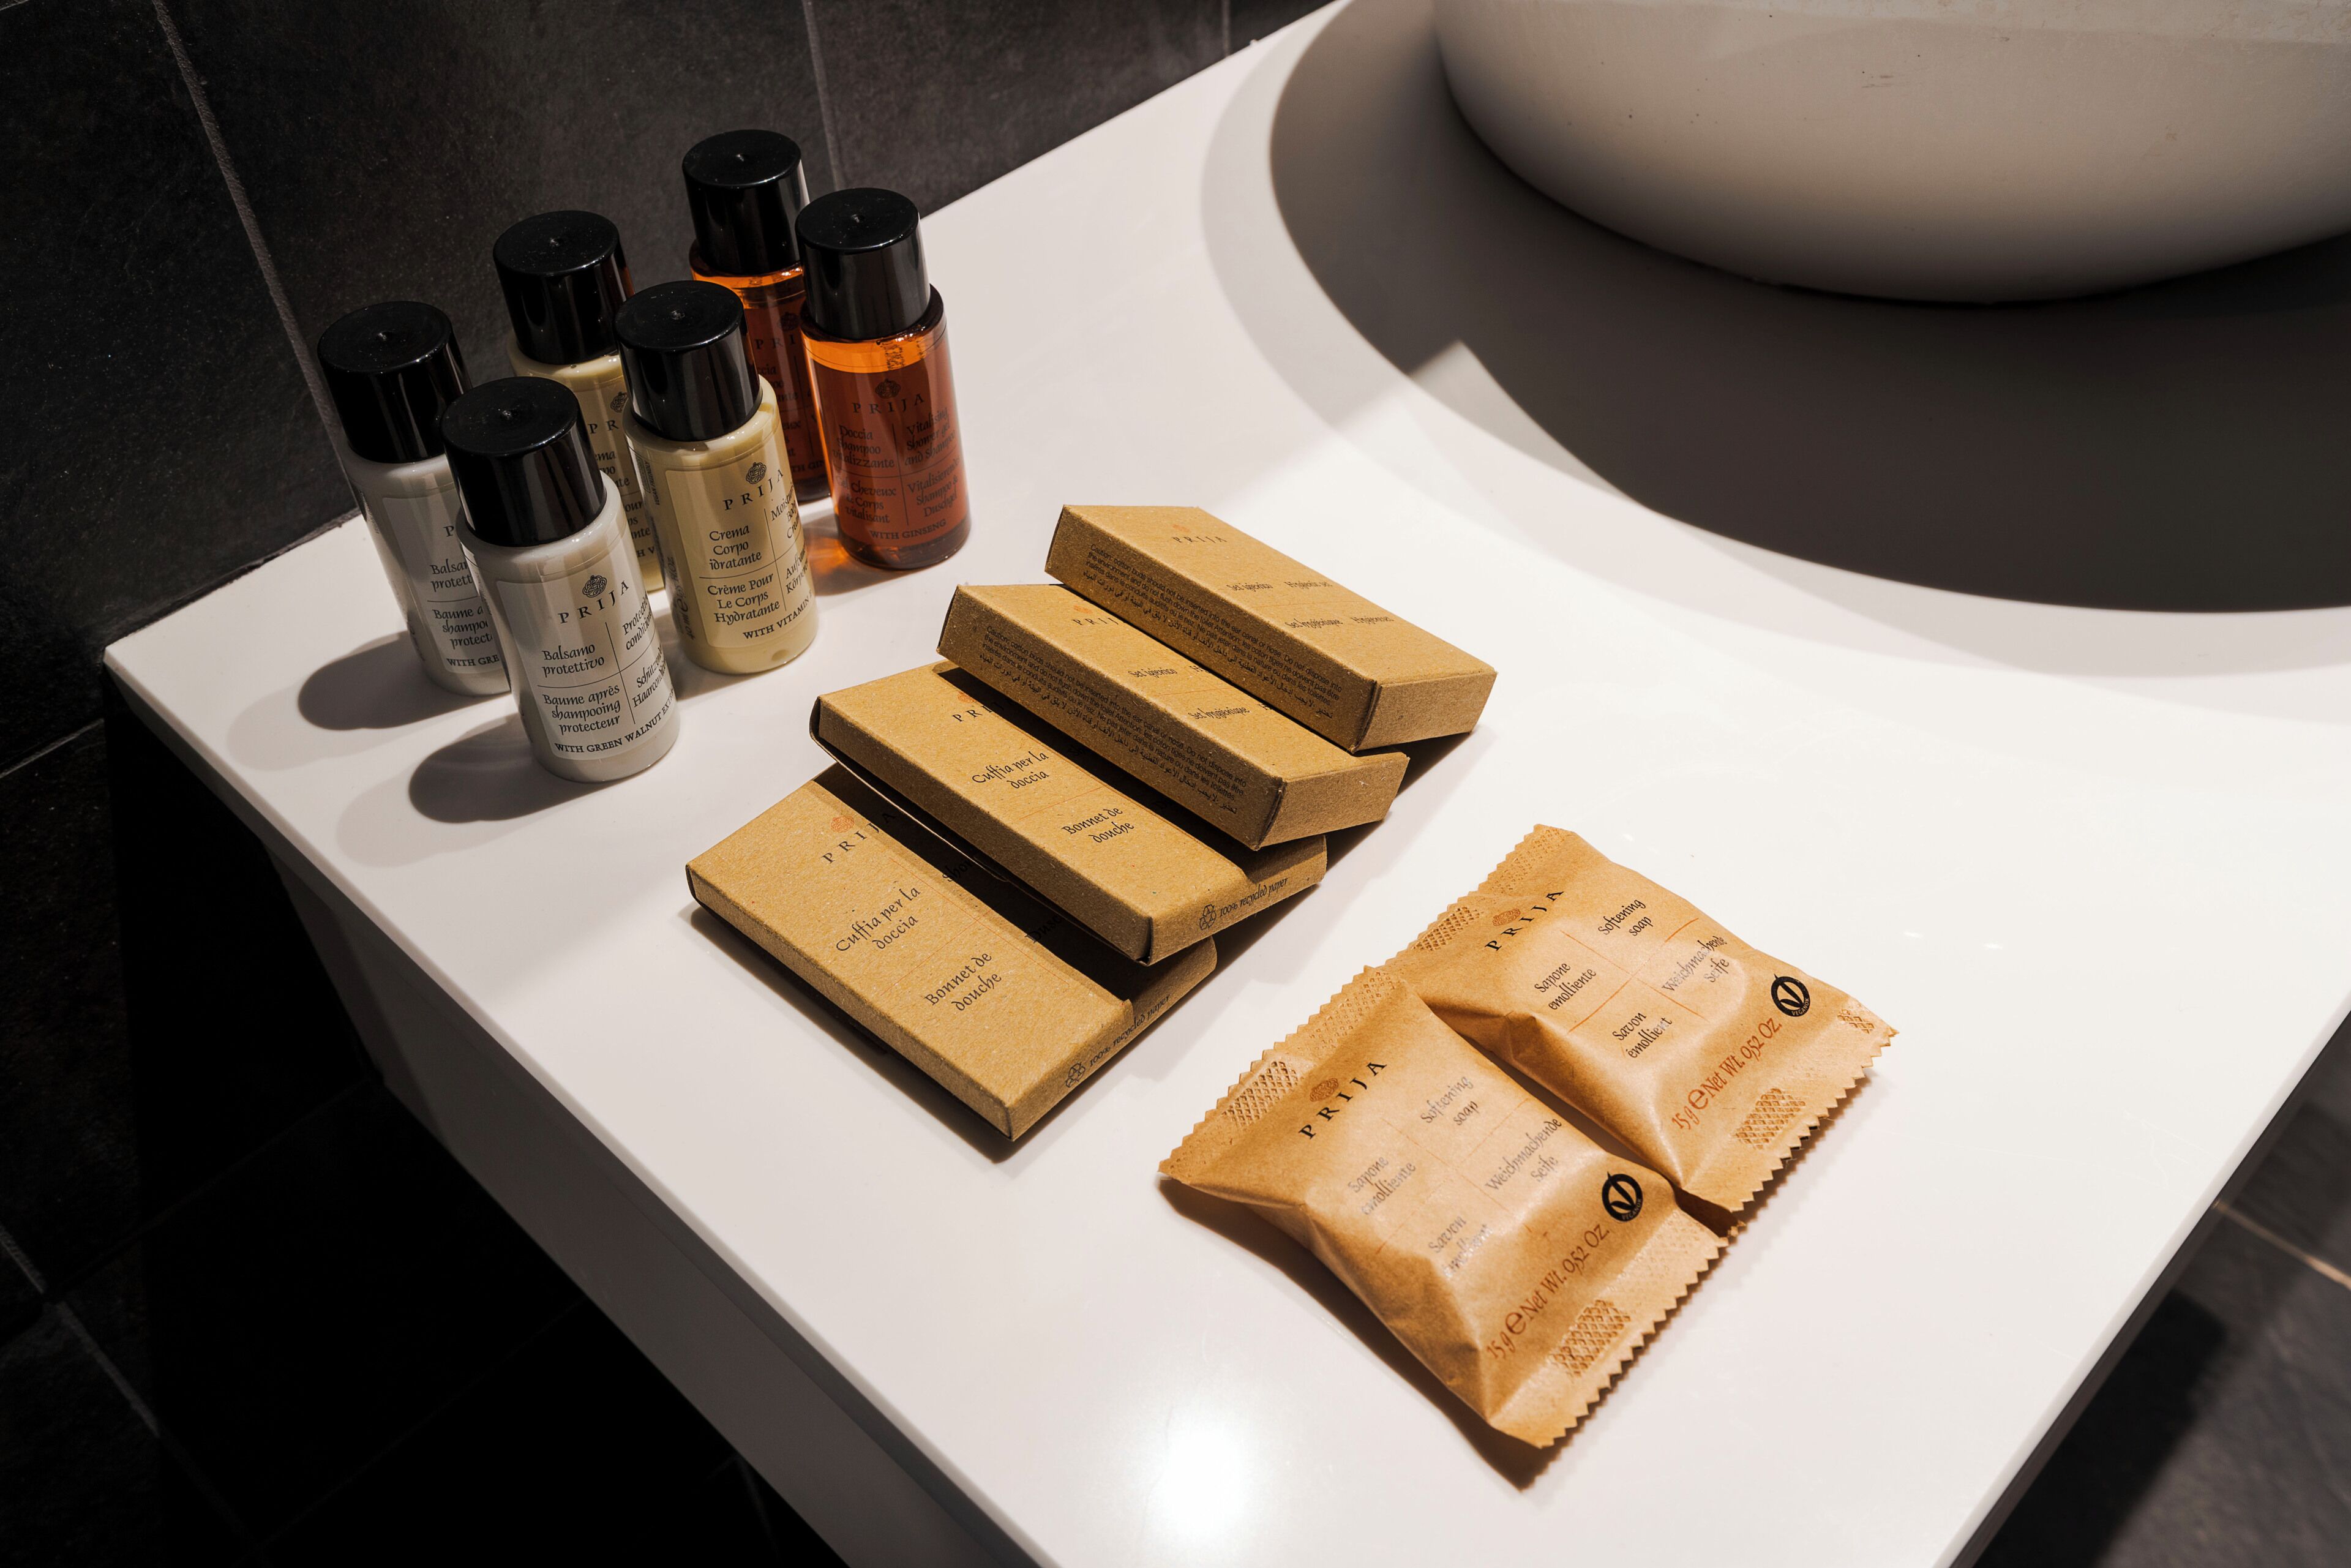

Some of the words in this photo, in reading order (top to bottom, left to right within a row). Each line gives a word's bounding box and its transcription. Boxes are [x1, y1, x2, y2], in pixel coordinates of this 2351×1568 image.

[852, 394, 924, 415] PRIJA
[839, 424, 872, 440] Doccia
[907, 430, 939, 451] Shower
[723, 468, 784, 511] PRIJA
[851, 479, 896, 497] Cheveux
[846, 506, 890, 524] vitalisant
[854, 497, 884, 512] Corps
[709, 525, 749, 541] Crema
[870, 530, 899, 539] WITH
[902, 519, 946, 538] GINSENG
[709, 552, 762, 571] idratante
[713, 541, 749, 555] Corpo
[707, 583, 746, 596] Crème
[749, 573, 773, 590] Pour
[1226, 583, 1242, 591] Set
[1242, 582, 1273, 592] igienico
[558, 580, 629, 624] PRIJA
[714, 600, 780, 625] Hydratante
[717, 599, 732, 609] Le
[735, 590, 769, 606] Corps
[432, 609, 474, 620] Baume
[743, 624, 774, 639] WITH
[776, 599, 809, 628] VITAMIN
[1073, 617, 1119, 626] PRIJ
[1087, 552, 1097, 561] the
[1130, 576, 1141, 586] and
[1141, 582, 1149, 591] do
[1150, 587, 1159, 596] not
[1159, 593, 1172, 604] flush
[1174, 601, 1190, 614] down
[1190, 610, 1199, 620] the
[1200, 616, 1213, 628] toilet
[1242, 640, 1251, 650] les
[1251, 645, 1269, 660] coton
[1268, 655, 1283, 670] tiges
[1292, 669, 1314, 686] doivent
[1314, 683, 1325, 694] pas
[1113, 556, 1131, 572] cotton
[1131, 566, 1146, 580] buds
[1146, 575, 1166, 591] should
[1165, 586, 1176, 598] not
[1176, 592, 1185, 603] be
[1185, 597, 1209, 616] inserted
[1209, 610, 1220, 623] into
[1220, 617, 1231, 629] the
[1231, 625, 1241, 635] ear
[1242, 629, 1259, 645] canal
[1258, 640, 1265, 649] or
[1283, 653, 1294, 665] Do
[1294, 659, 1305, 671] not
[1305, 666, 1330, 687] dispose
[1330, 680, 1343, 692] into
[446, 658, 476, 667] WITH
[542, 644, 595, 661] Balsamo
[542, 656, 604, 678] protettivo
[1128, 669, 1144, 678] Set
[1145, 666, 1177, 679] igienico
[542, 694, 585, 705] Baume
[588, 685, 620, 703] après
[552, 700, 621, 721] shampooing
[1188, 711, 1204, 720] Set
[555, 743, 585, 753] WITH
[587, 738, 623, 752] GREEN
[624, 711, 662, 743] WALNUT
[558, 715, 620, 735] protecteur
[972, 765, 1014, 784] Cuffia
[1012, 758, 1033, 773] per
[1028, 751, 1049, 763] la
[1007, 771, 1049, 789] doccia
[1062, 812, 1109, 835] Bonnet
[1105, 806, 1123, 817] de
[1088, 822, 1134, 843] douche
[822, 812, 897, 864] PRIJA
[1220, 902, 1238, 917] 100%
[1240, 883, 1267, 907] recycled
[1269, 878, 1288, 898] paper
[836, 916, 882, 951] Cuffia
[880, 898, 903, 922] per
[899, 887, 921, 901] la
[1485, 891, 1564, 951] PRIJA
[1597, 899, 1646, 936] Softening
[1629, 915, 1654, 937] soap
[872, 915, 918, 950] doccia
[924, 964, 975, 1006] Bonnet
[972, 951, 992, 967] de
[1534, 962, 1572, 993] Sapone
[1703, 957, 1730, 983] Seife
[951, 972, 1001, 1011] douche
[1548, 968, 1597, 1011] emolliente
[1791, 998, 1809, 1016] VEGANOK
[1089, 1046, 1111, 1067] 100%
[1112, 1014, 1146, 1048] recycled
[1147, 994, 1170, 1021] paper
[1613, 1011, 1647, 1042] Savon
[1625, 1016, 1673, 1060] émollient
[1671, 1112, 1691, 1130] 15
[1700, 1071, 1728, 1098] Net
[1719, 1054, 1745, 1078] Wt.
[1740, 1035, 1765, 1062] 0,52
[1758, 1018, 1783, 1039] Oz.
[1298, 1060, 1387, 1139] PRIJA
[1420, 1076, 1474, 1124] Softening
[1453, 1100, 1478, 1127] soap
[1485, 1117, 1562, 1193] Weichmachende
[1348, 1156, 1389, 1194] Sapone
[1530, 1155, 1558, 1183] Seife
[1361, 1162, 1416, 1216] emolliente
[1428, 1215, 1466, 1254] Savon
[1485, 1339, 1507, 1360] 15
[1519, 1289, 1548, 1320] Net
[1540, 1269, 1568, 1295] Wt.
[1562, 1246, 1589, 1275] 0,52
[1584, 1223, 1610, 1248] Oz.
